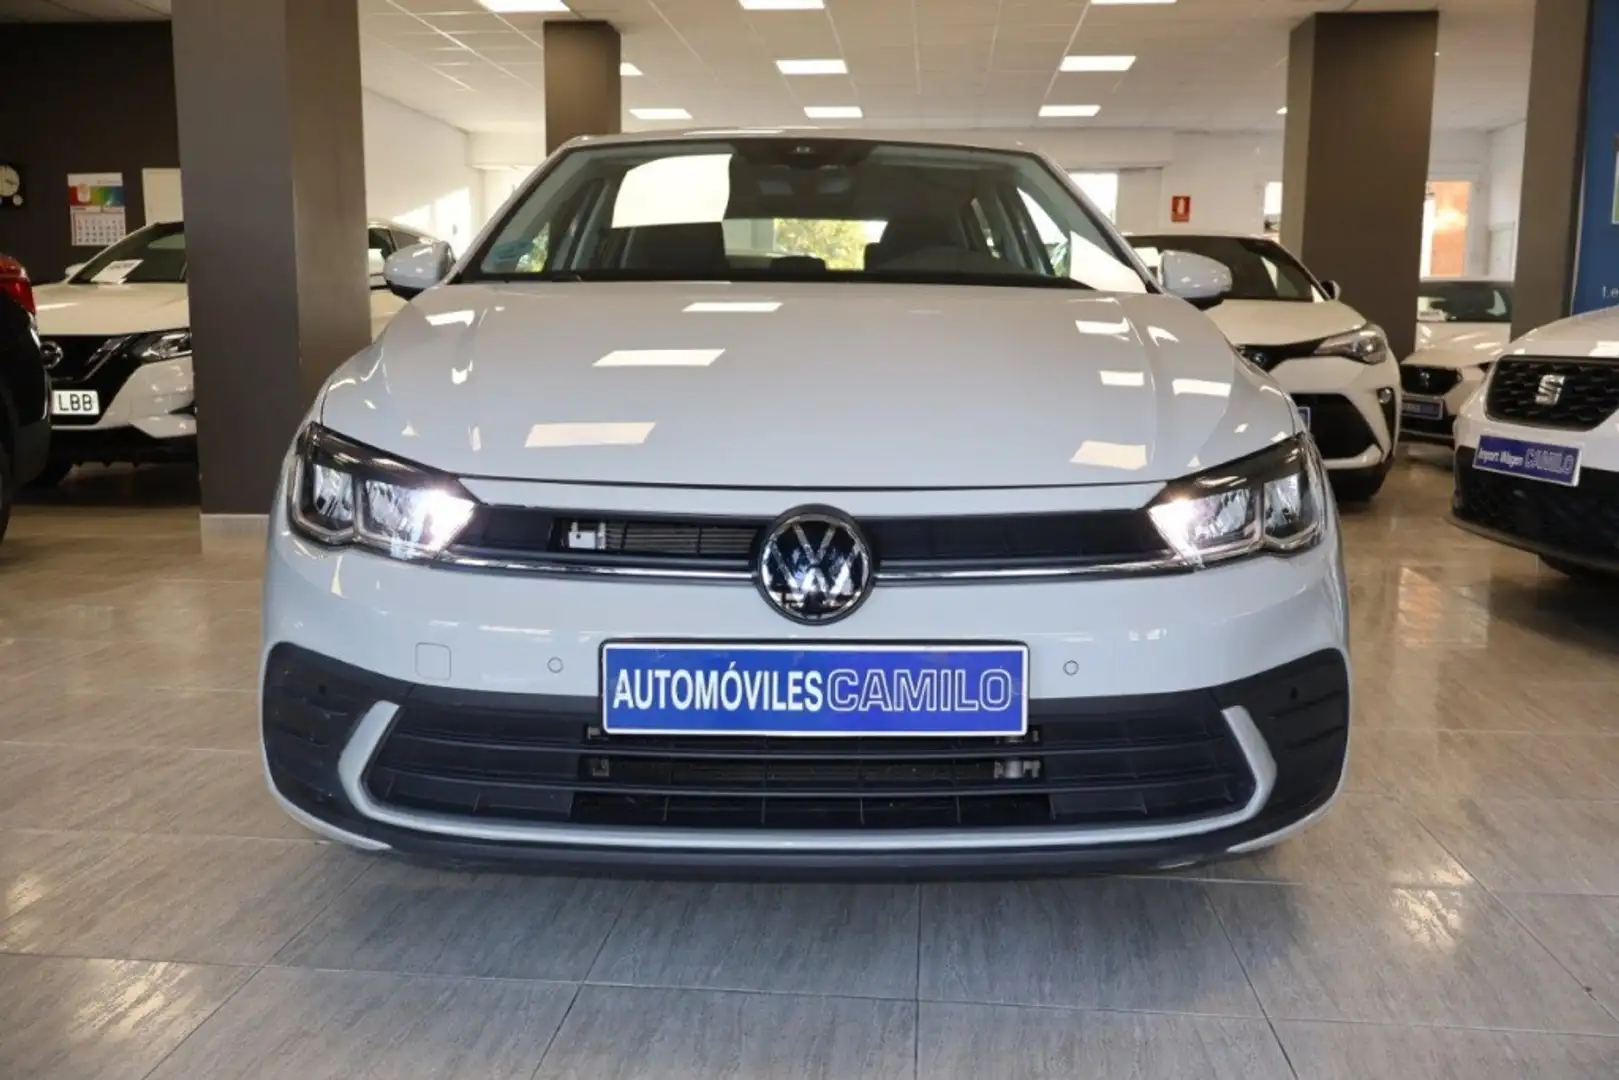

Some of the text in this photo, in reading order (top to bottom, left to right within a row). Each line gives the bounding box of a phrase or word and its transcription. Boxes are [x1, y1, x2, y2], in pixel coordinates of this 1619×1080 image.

[58, 393, 93, 411] LBB
[612, 661, 1013, 712] AUTOMÓVILES CAMILO
